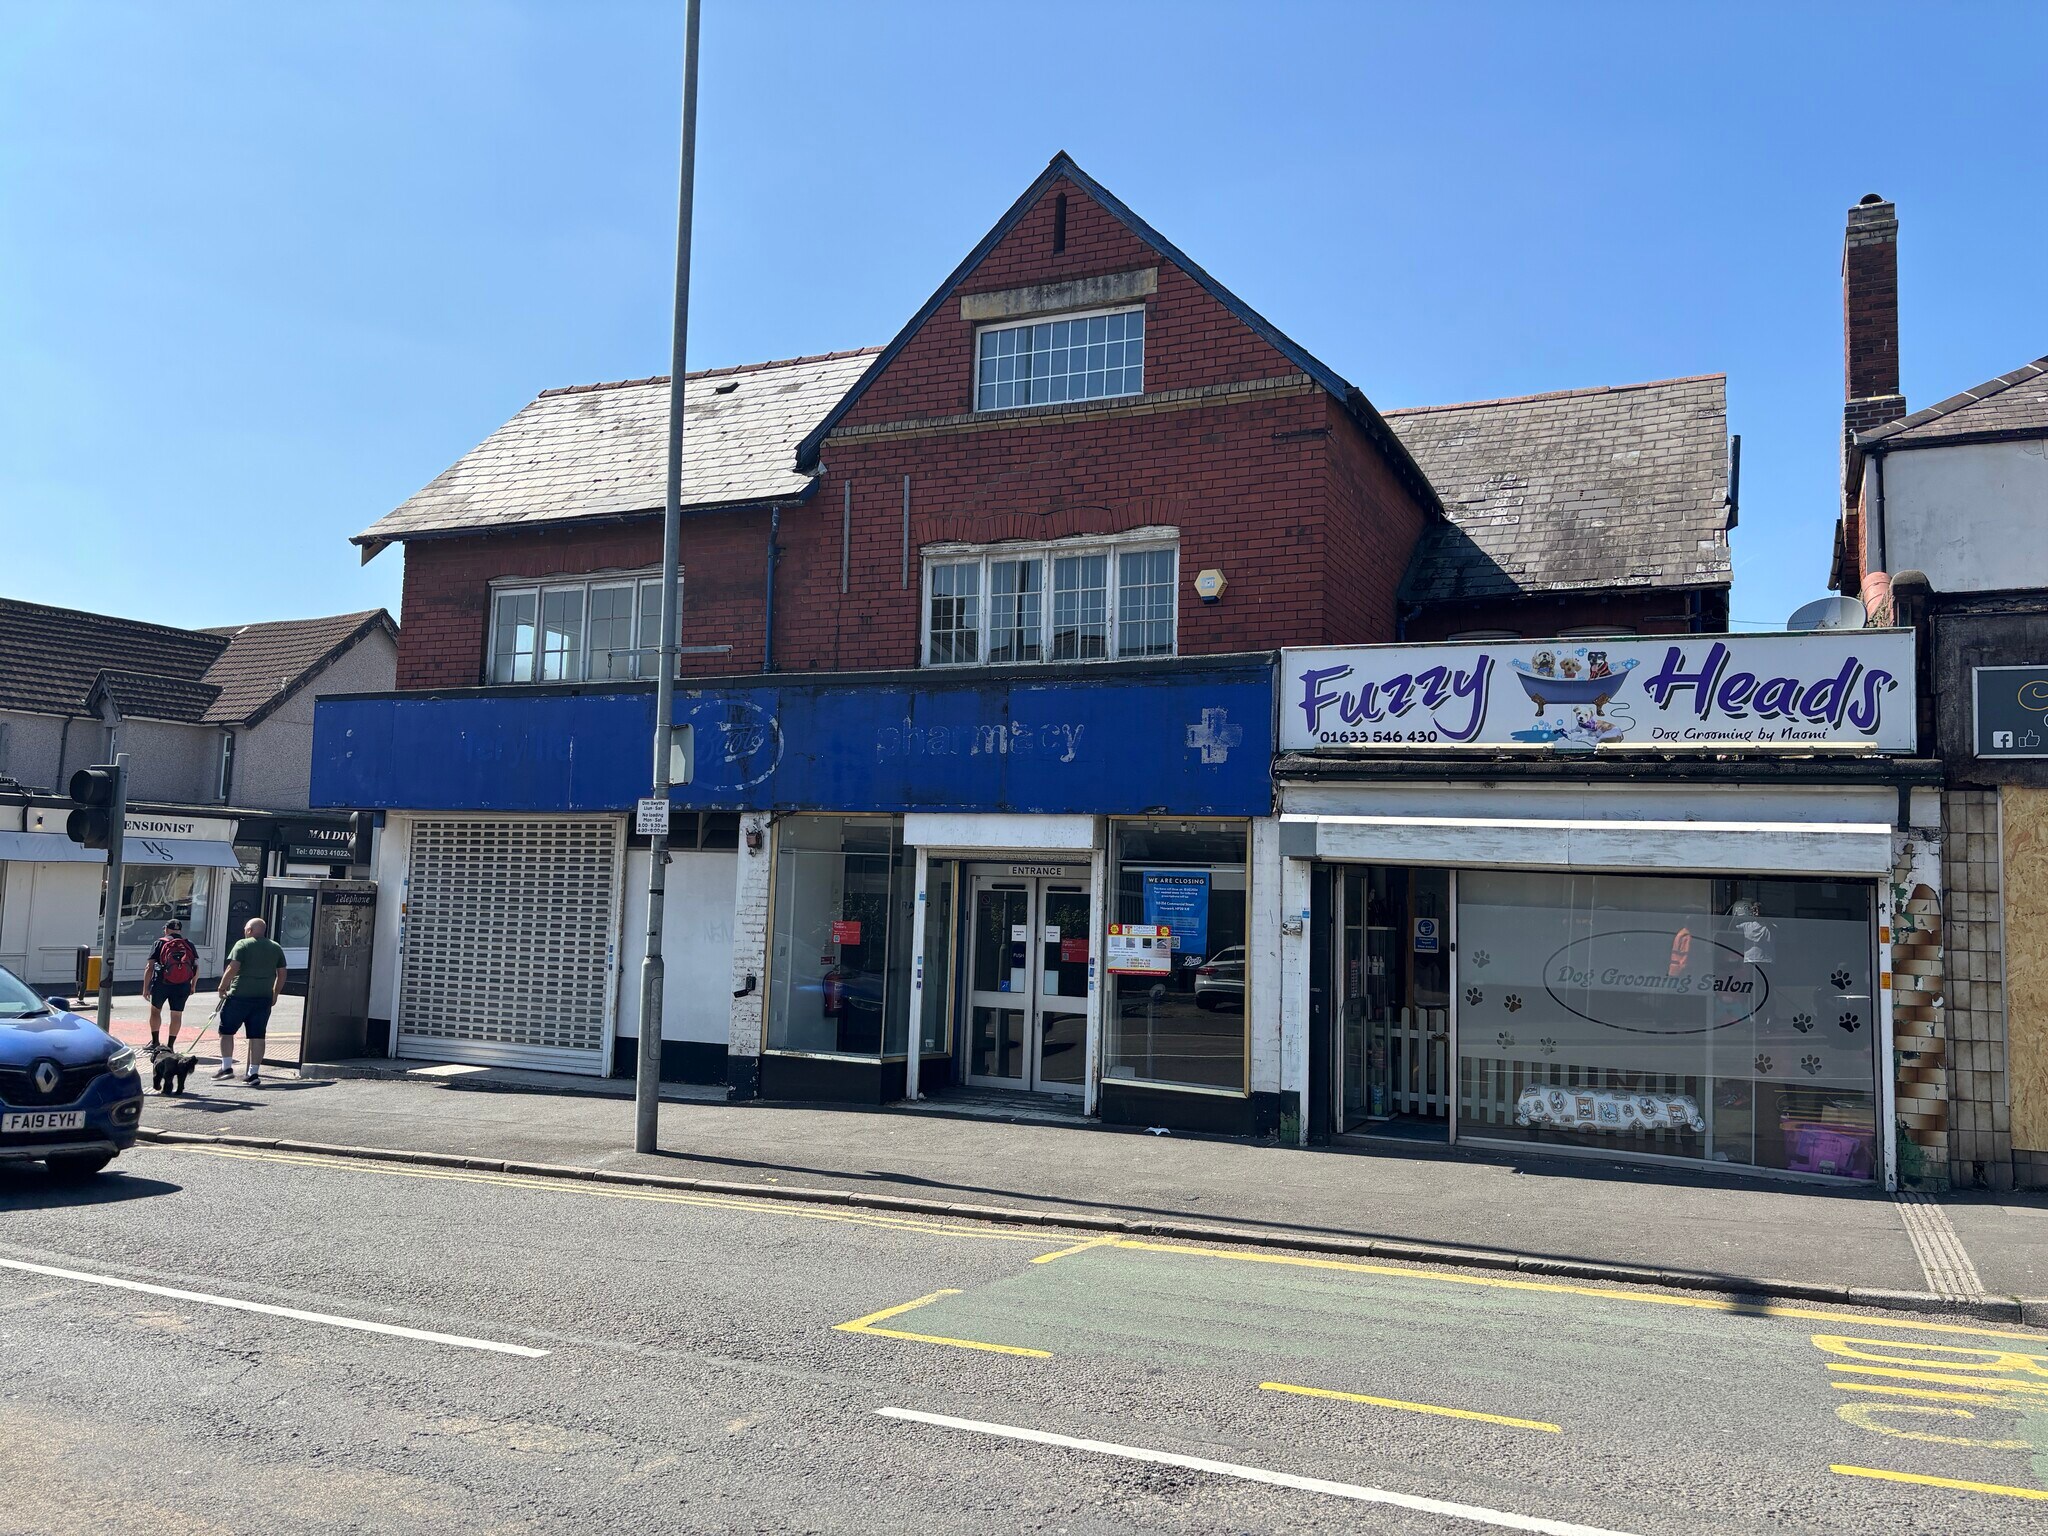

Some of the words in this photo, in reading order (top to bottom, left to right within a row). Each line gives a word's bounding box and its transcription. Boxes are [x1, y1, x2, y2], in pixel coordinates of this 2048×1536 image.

[1298, 654, 1496, 743] Fuzzy
[1643, 641, 1898, 736] Heads
[876, 714, 1085, 764] pharmacy
[1320, 730, 1369, 743] 01633
[1372, 730, 1403, 743] 546
[1406, 730, 1438, 743] 430
[1651, 727, 1680, 742] Dog
[1683, 727, 1754, 742] Grooming
[1757, 727, 1775, 742] by
[1781, 727, 1828, 740] Naomi
[123, 820, 195, 833] ENSIONIST
[1012, 866, 1062, 876] ENTRANCE
[1557, 966, 1595, 988] Dog
[1600, 968, 1692, 994] Grooming
[1696, 974, 1754, 994] Salon
[11, 1114, 45, 1129] FA19
[48, 1113, 77, 1127] EYH
